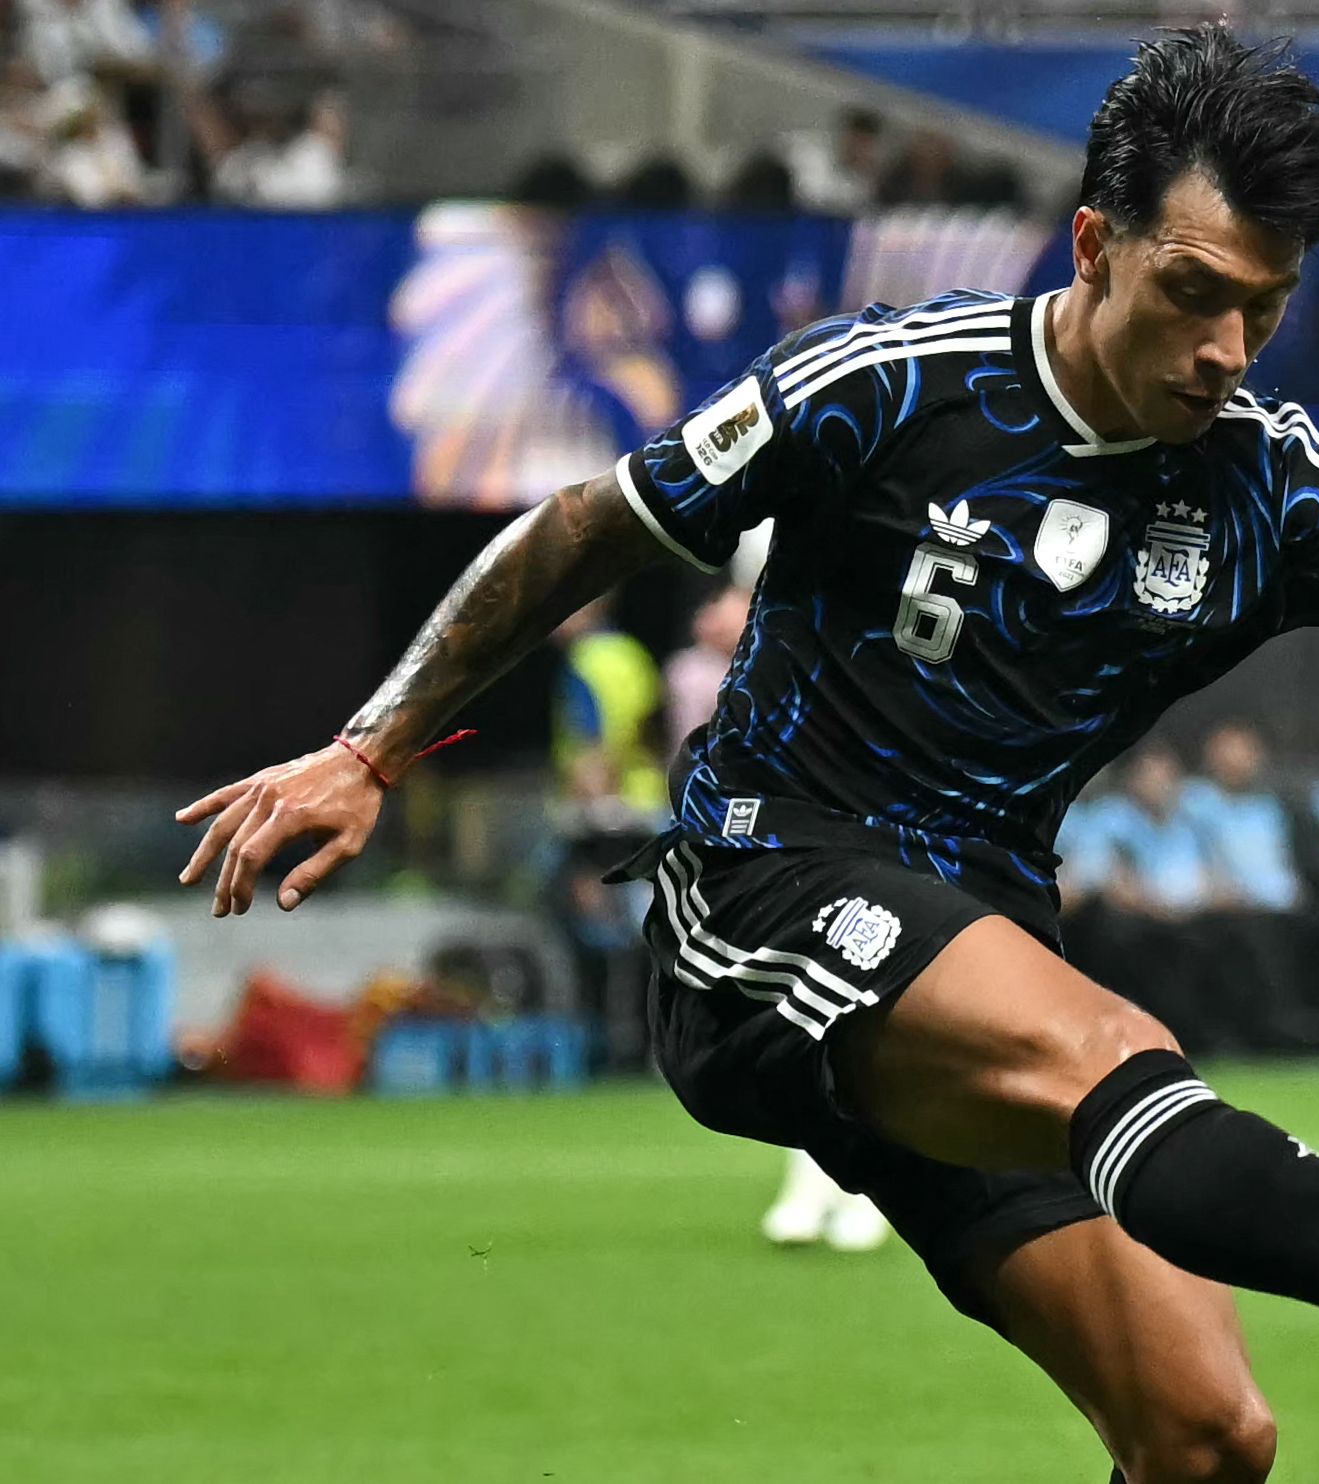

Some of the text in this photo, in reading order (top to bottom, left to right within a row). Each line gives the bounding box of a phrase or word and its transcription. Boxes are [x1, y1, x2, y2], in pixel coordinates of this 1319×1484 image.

[1150, 548, 1192, 587] AFA
[892, 541, 980, 664] 6
[846, 917, 881, 952] AFA
